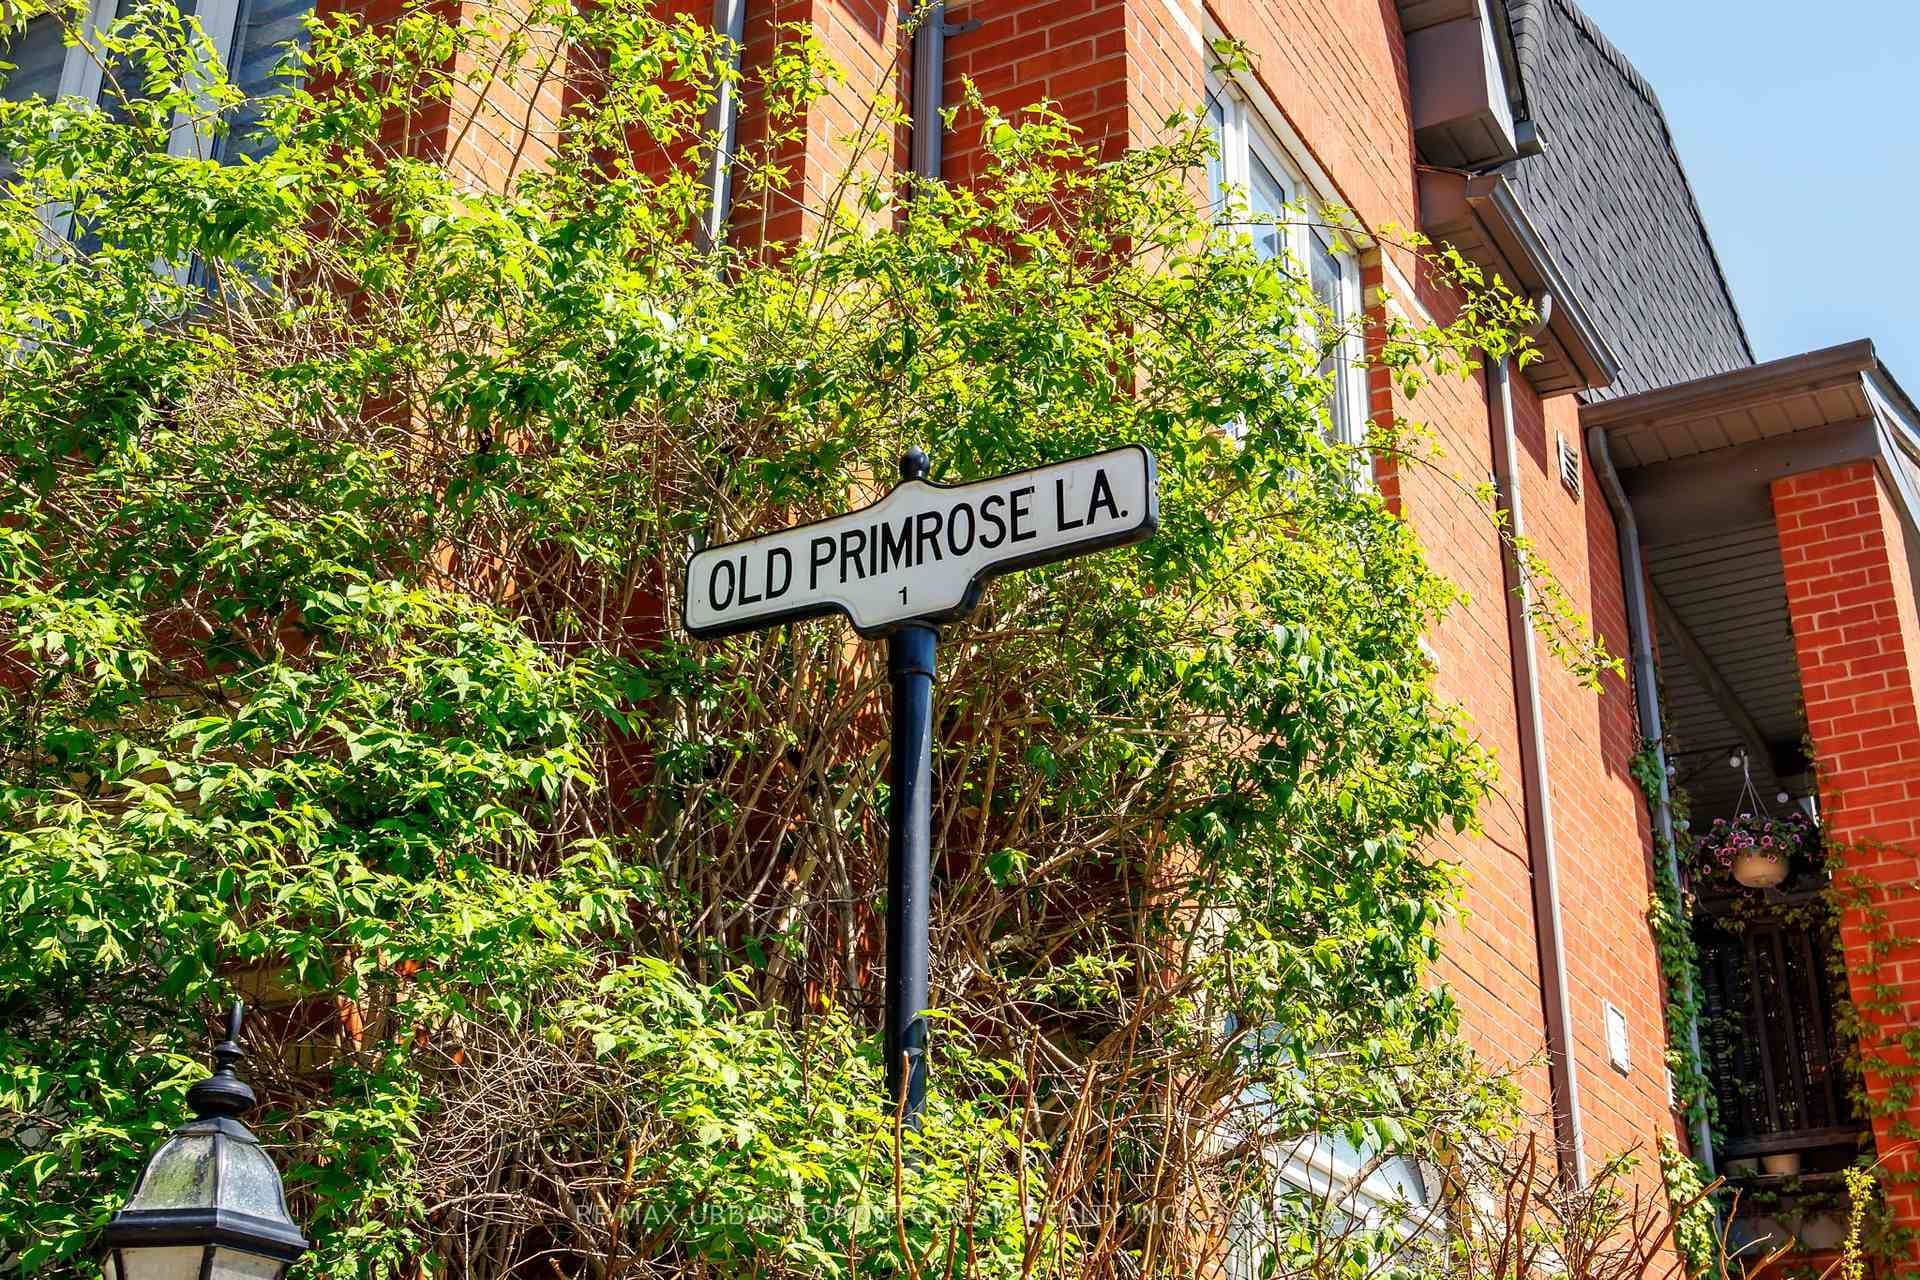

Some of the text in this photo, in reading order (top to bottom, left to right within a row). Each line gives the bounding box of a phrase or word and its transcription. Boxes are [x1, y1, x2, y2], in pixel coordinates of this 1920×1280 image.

[708, 468, 1129, 612] OLD PRIMROSE LA.
[898, 586, 908, 606] 1
